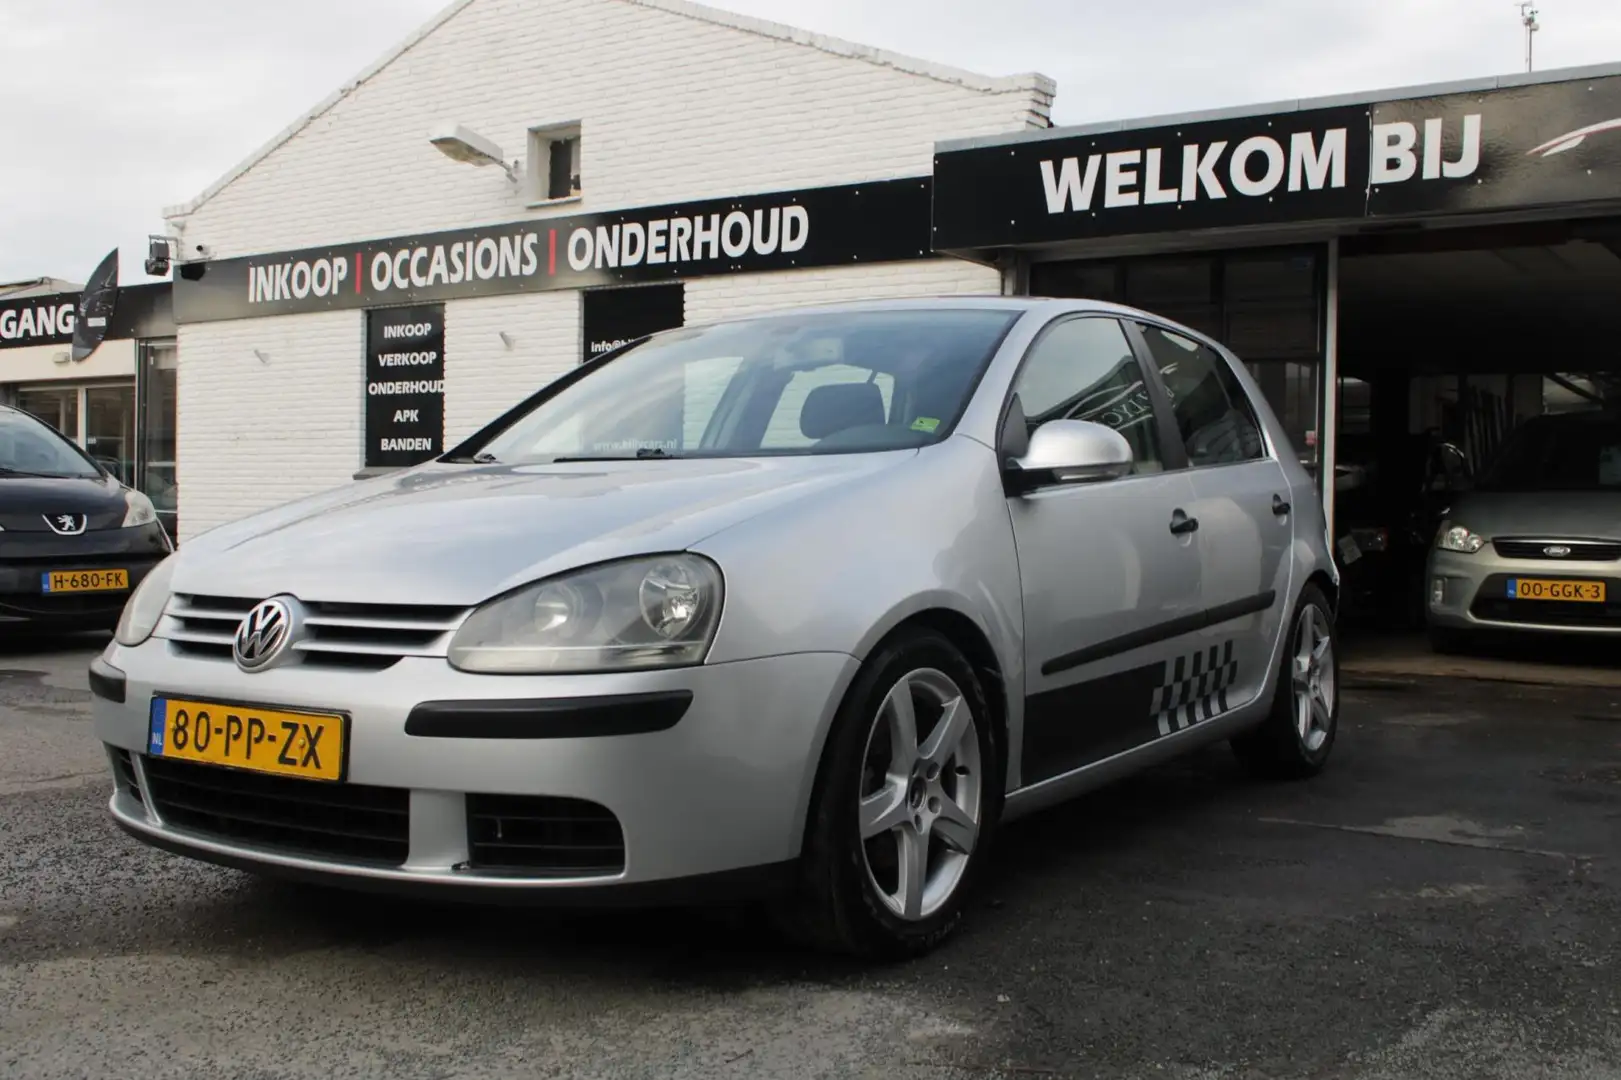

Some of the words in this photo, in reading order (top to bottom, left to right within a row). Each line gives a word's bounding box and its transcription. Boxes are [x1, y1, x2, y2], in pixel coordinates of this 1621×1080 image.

[1040, 128, 1347, 214] WELKOM
[1371, 114, 1481, 184] BIJ
[248, 256, 348, 303] INKOOP
[371, 232, 538, 291] OCCASIONS
[567, 205, 809, 271] ONDERHOUD
[0, 303, 75, 339] GANG
[383, 322, 432, 339] INKOOP
[378, 351, 437, 367] VERKOOP
[368, 379, 444, 395] ONDERHOUD
[393, 409, 419, 423] APK
[380, 437, 432, 451] BANDEN
[53, 572, 124, 589] H-680-FK
[1520, 582, 1601, 599] 00-GGK-3
[173, 709, 324, 769] 80-PP-ZX
